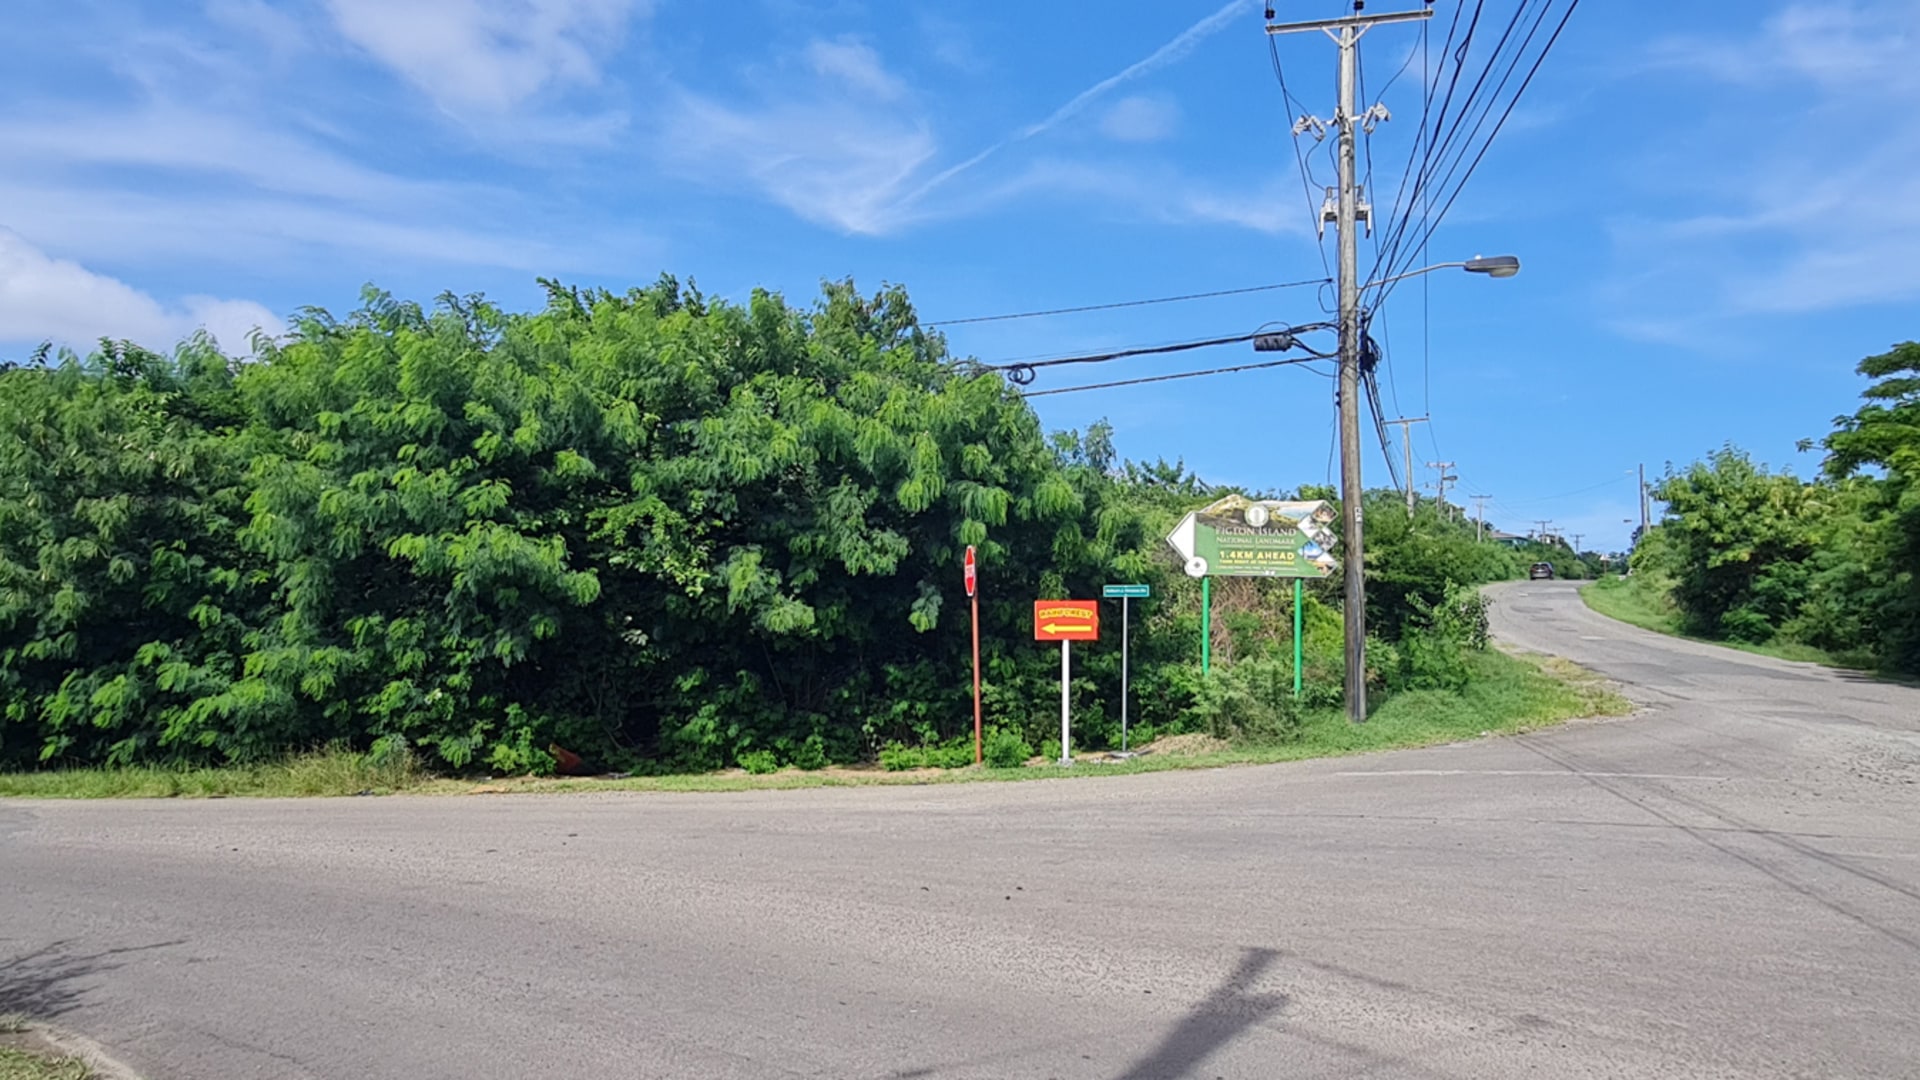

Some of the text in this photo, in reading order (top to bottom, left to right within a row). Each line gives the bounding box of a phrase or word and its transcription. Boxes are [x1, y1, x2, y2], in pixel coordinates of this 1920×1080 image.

[1259, 526, 1296, 536] ISLAND
[1220, 551, 1295, 560] 1.4KM AHEAD
